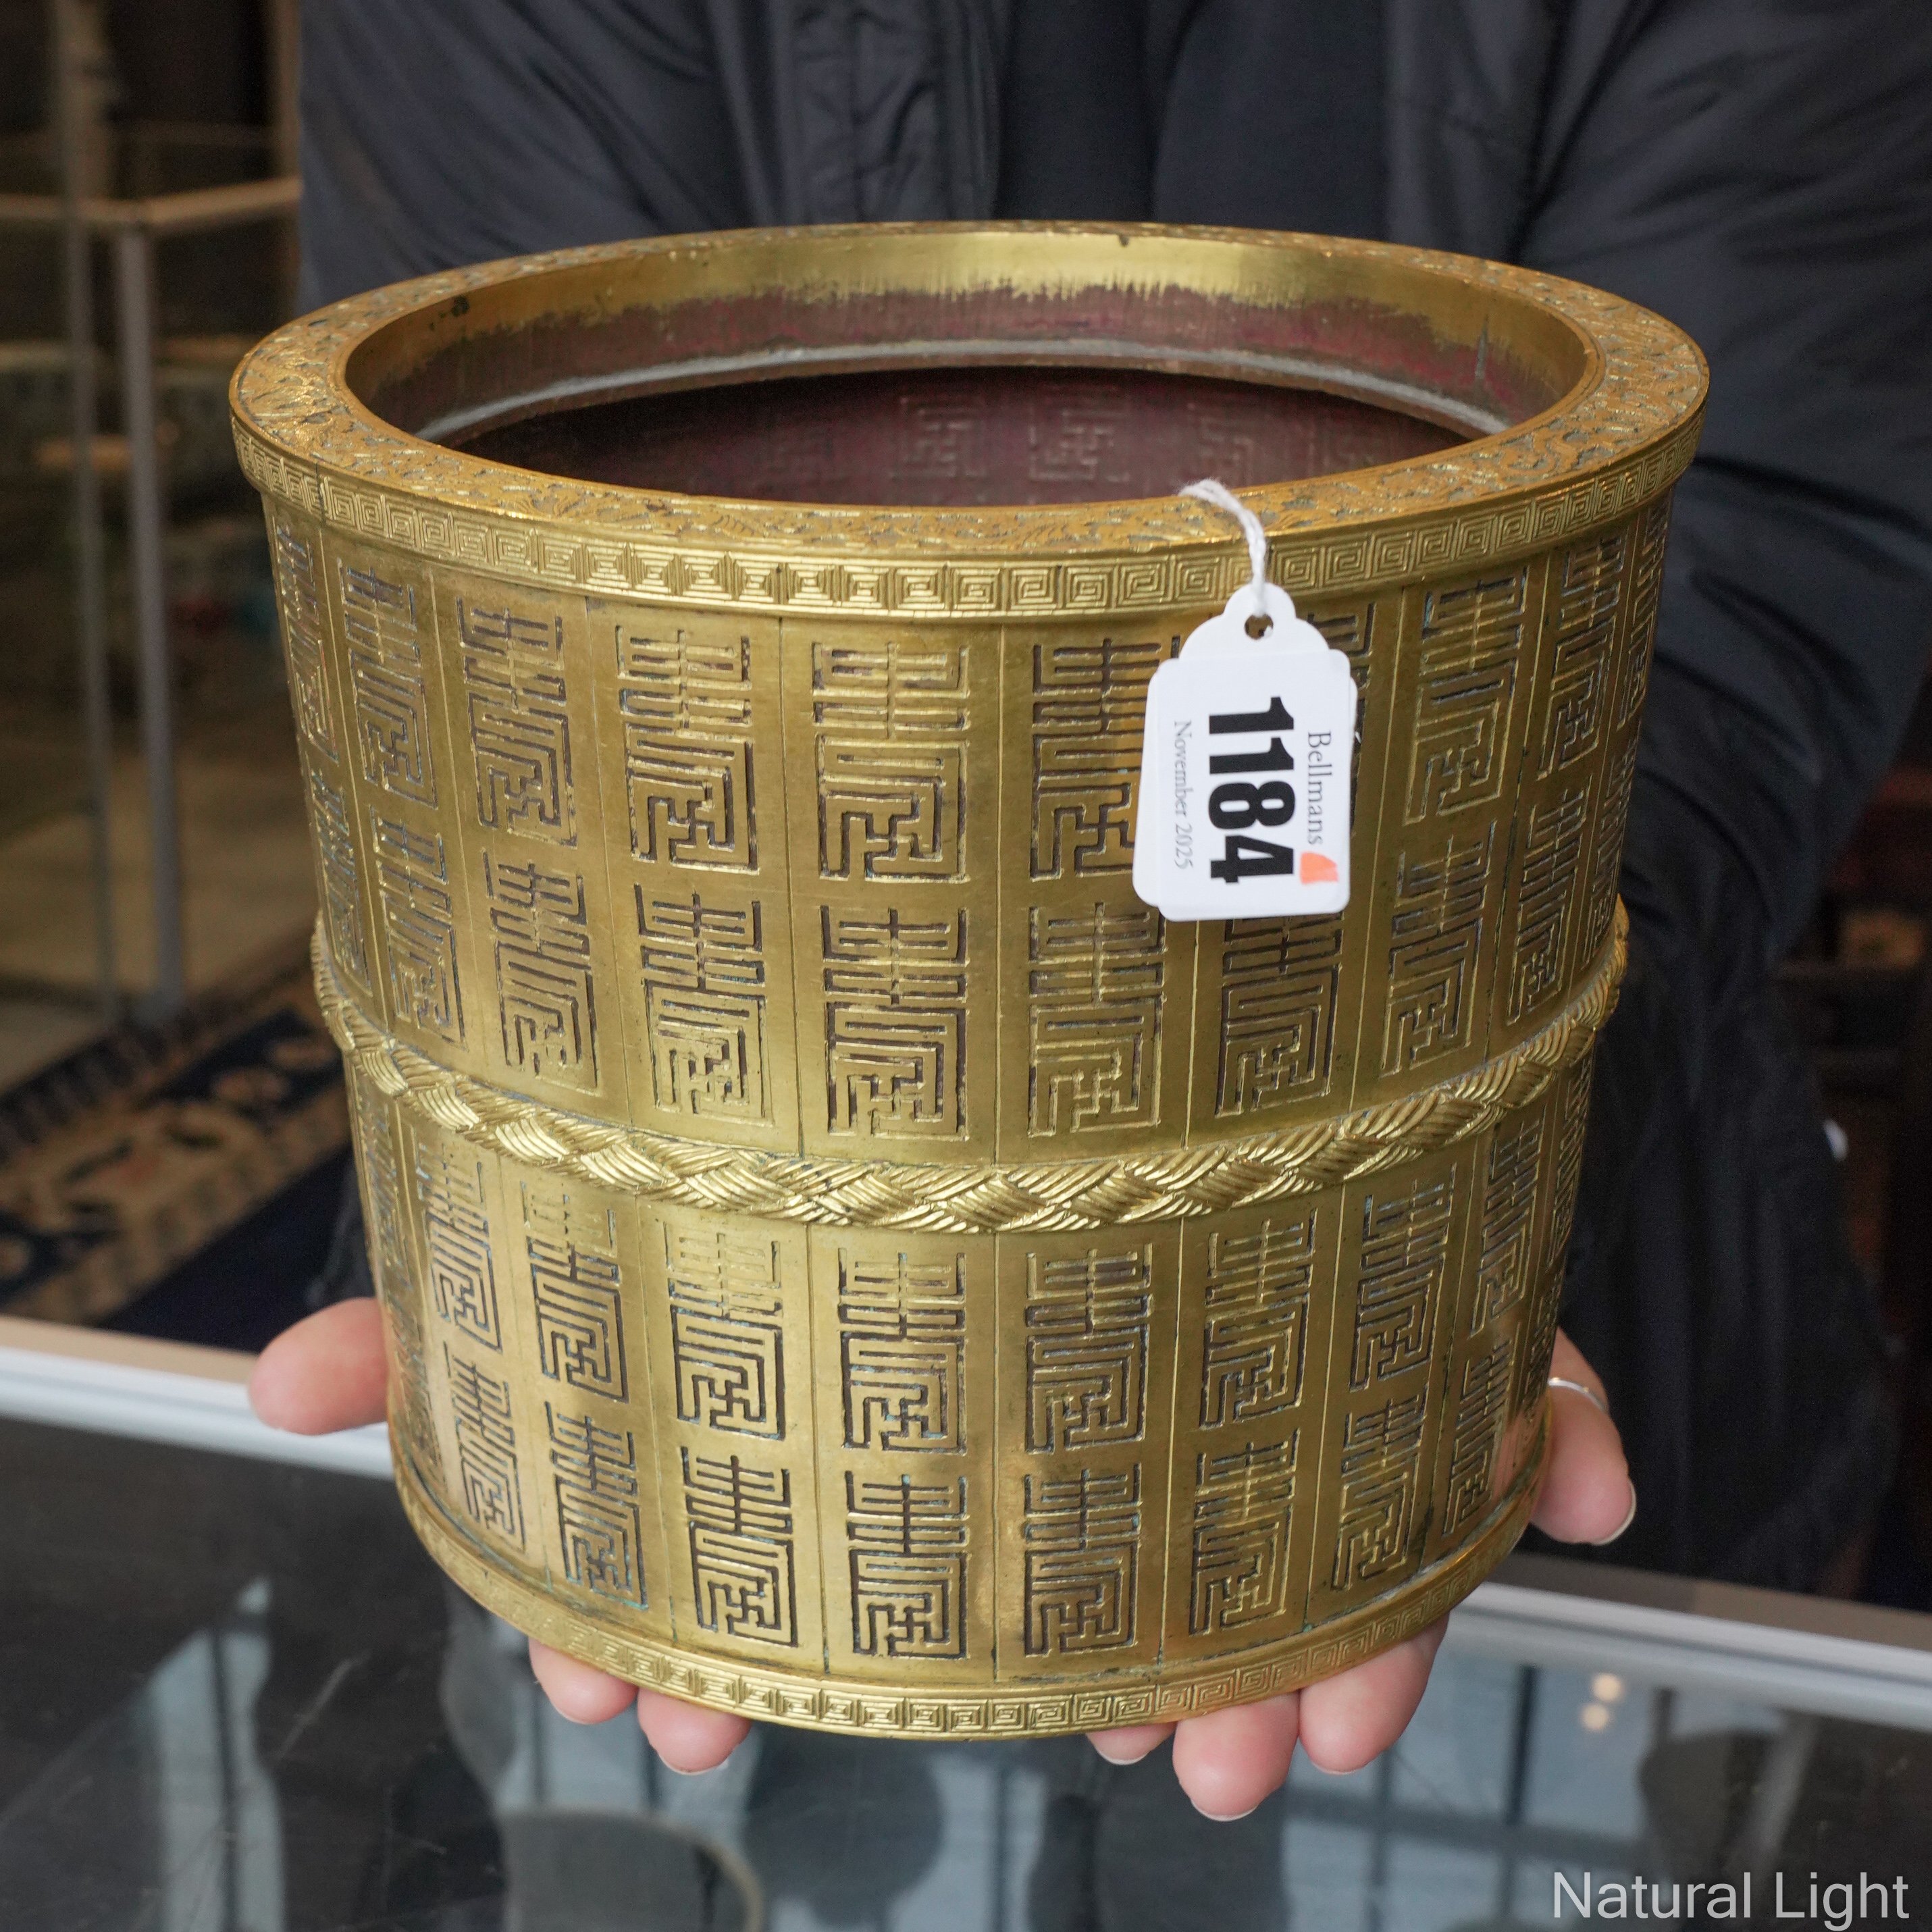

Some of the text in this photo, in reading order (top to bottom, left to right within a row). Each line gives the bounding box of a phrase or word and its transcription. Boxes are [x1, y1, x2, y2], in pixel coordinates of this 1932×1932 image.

[1174, 721, 1193, 869] November 2025
[1208, 696, 1296, 883] 1184
[1308, 731, 1333, 845] Bellmans
